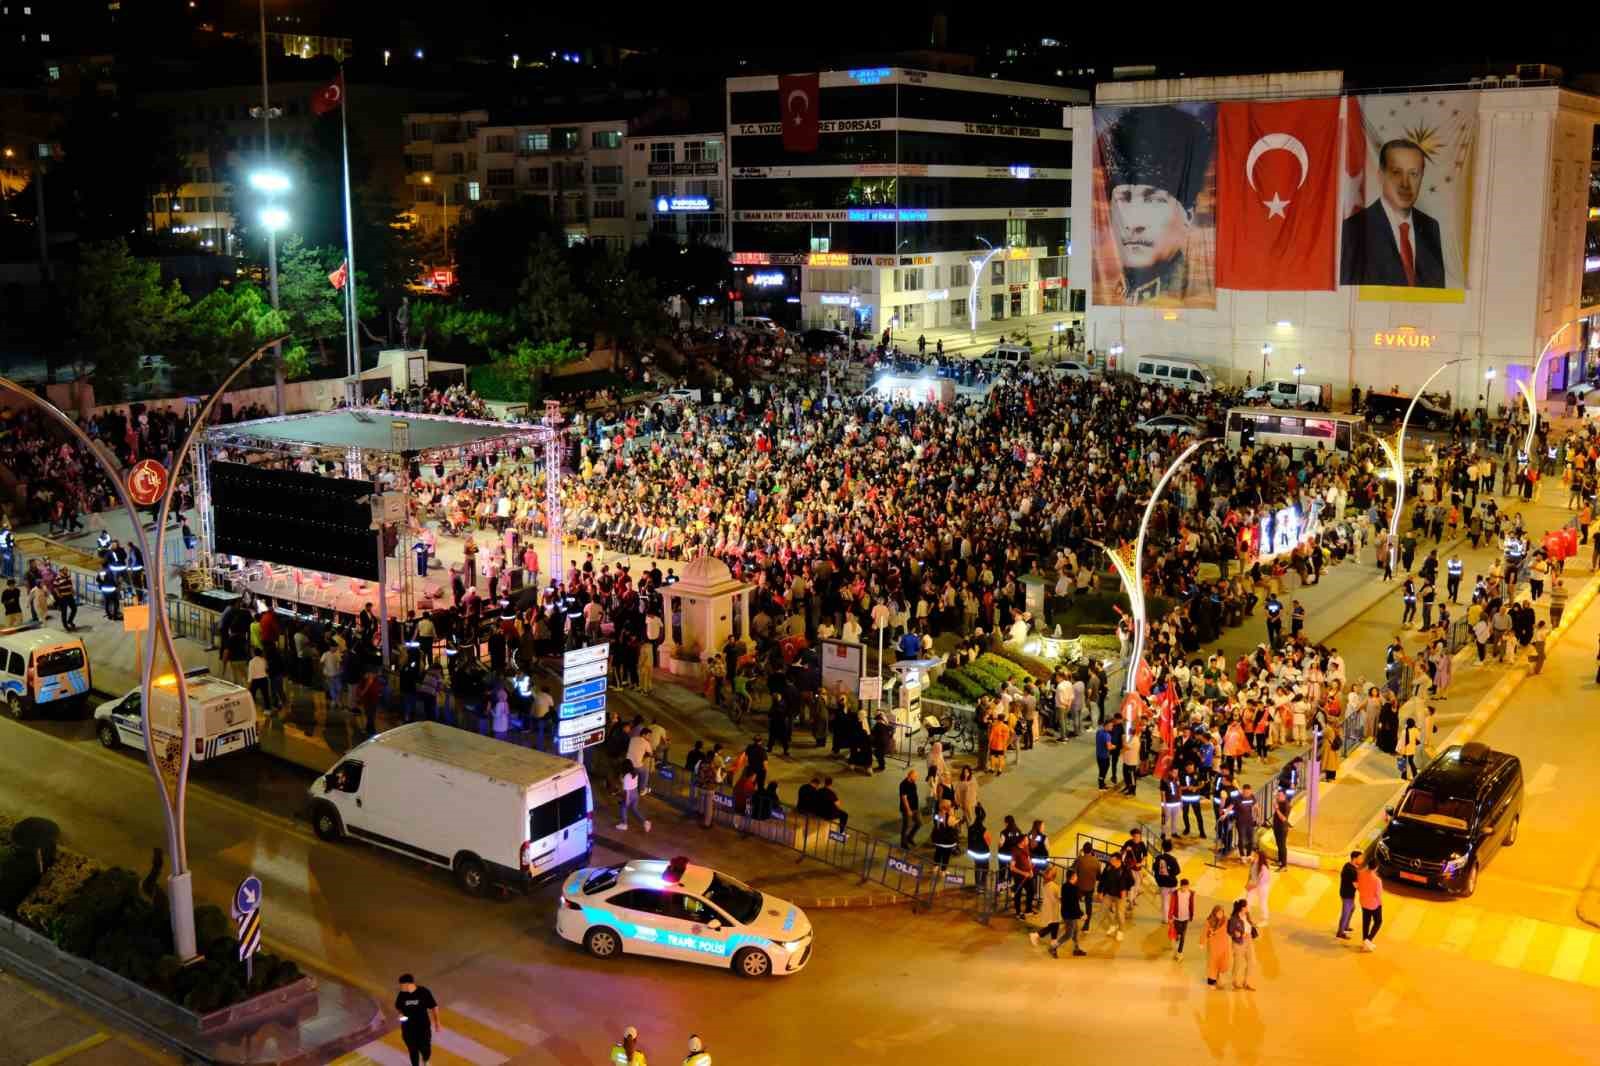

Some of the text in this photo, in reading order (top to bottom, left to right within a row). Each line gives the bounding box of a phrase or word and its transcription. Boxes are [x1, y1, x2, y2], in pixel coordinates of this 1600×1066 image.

[759, 123, 783, 134] YOZG
[838, 119, 881, 131] BORSASI
[887, 858, 919, 877] POLİS
